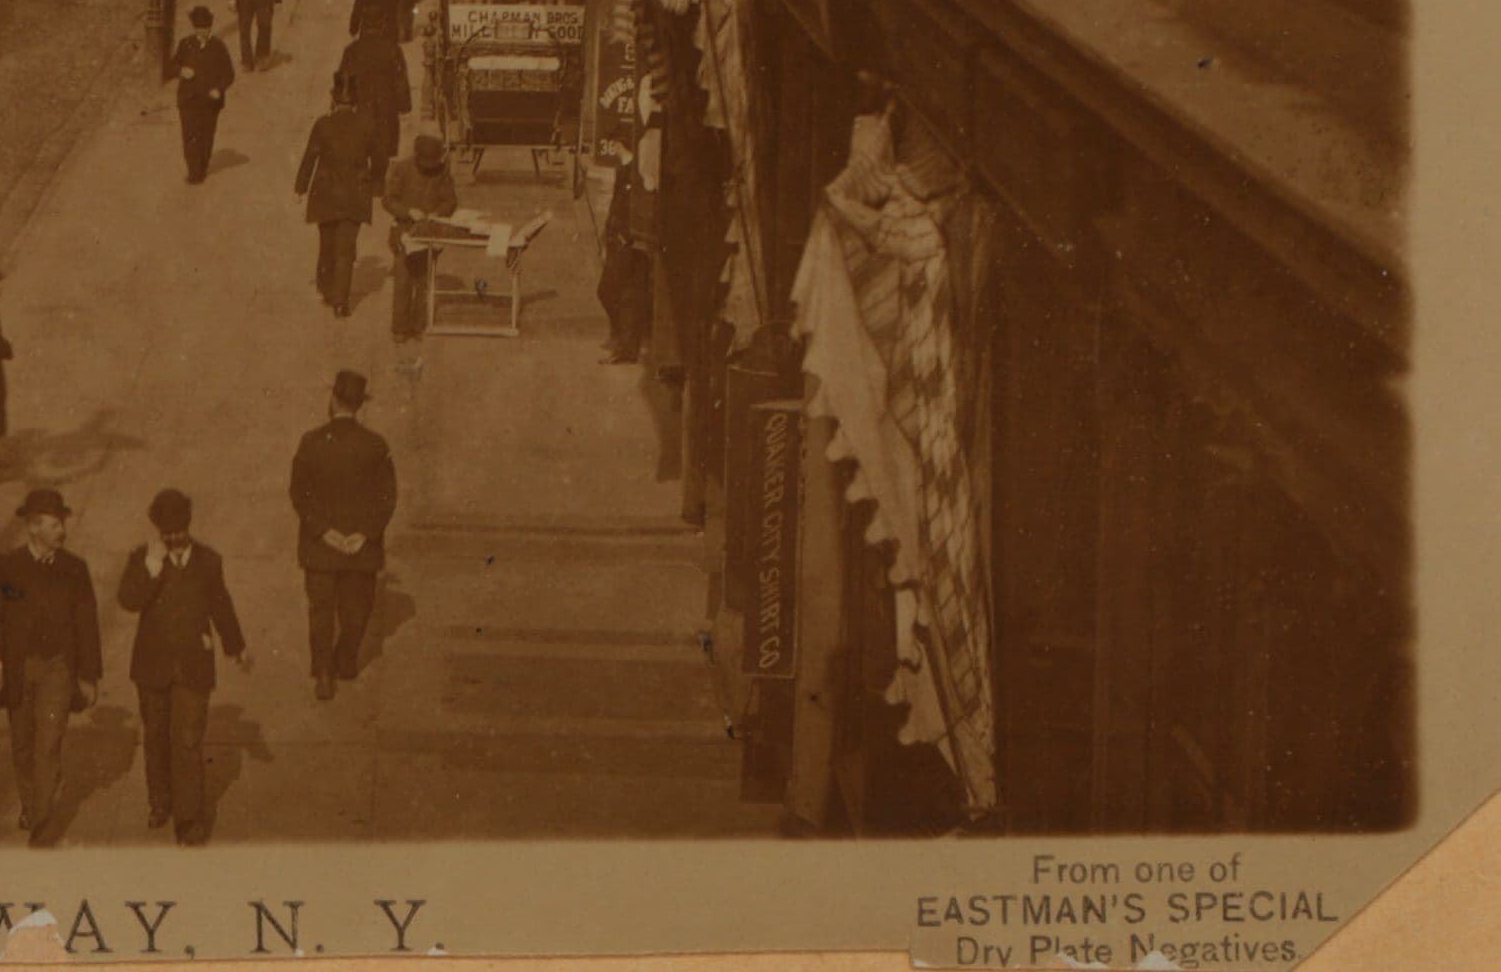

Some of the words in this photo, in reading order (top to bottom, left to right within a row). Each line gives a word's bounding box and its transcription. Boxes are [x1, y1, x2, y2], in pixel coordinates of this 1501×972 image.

[468, 10, 541, 23] CHAPMAN
[763, 412, 789, 509] QUAKER
[760, 510, 784, 563] CITY
[758, 566, 781, 634] SHIRT
